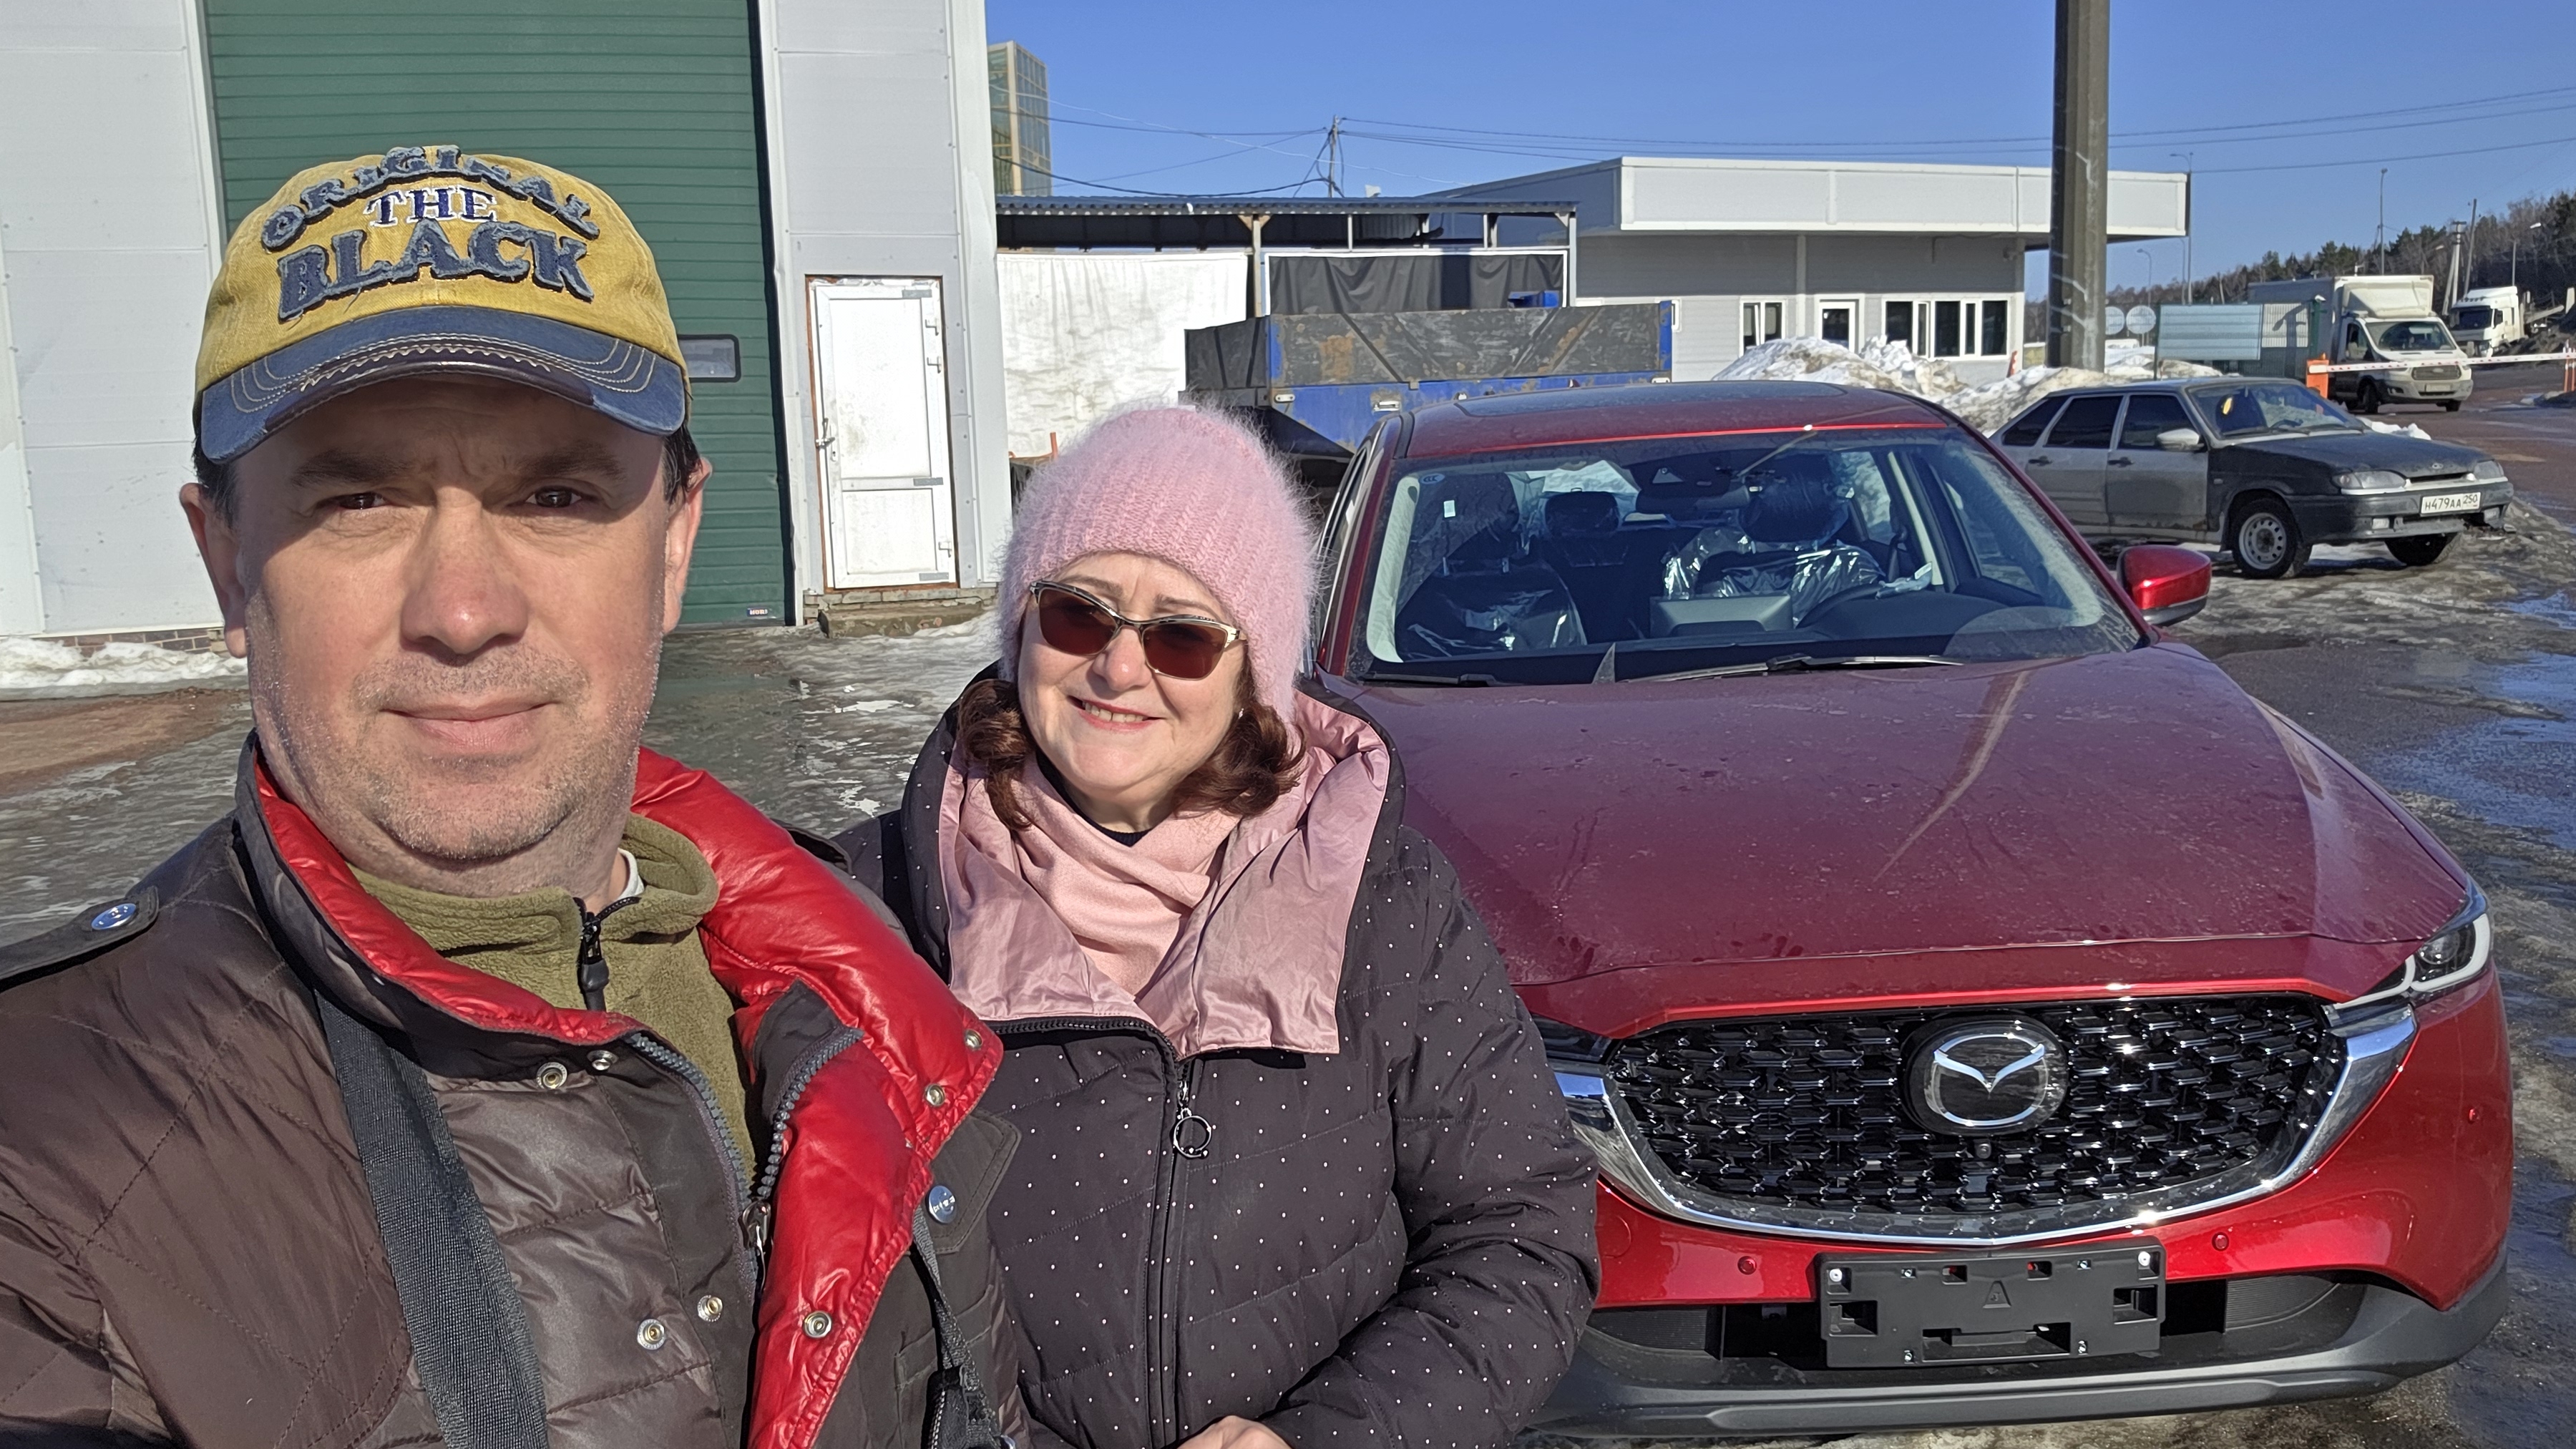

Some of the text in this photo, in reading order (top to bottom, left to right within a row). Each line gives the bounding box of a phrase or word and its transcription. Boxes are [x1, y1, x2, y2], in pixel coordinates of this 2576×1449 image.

[263, 145, 600, 251] ORIGINAL
[364, 186, 497, 227] THE
[278, 218, 595, 321] BLACK
[2463, 494, 2478, 504] 250
